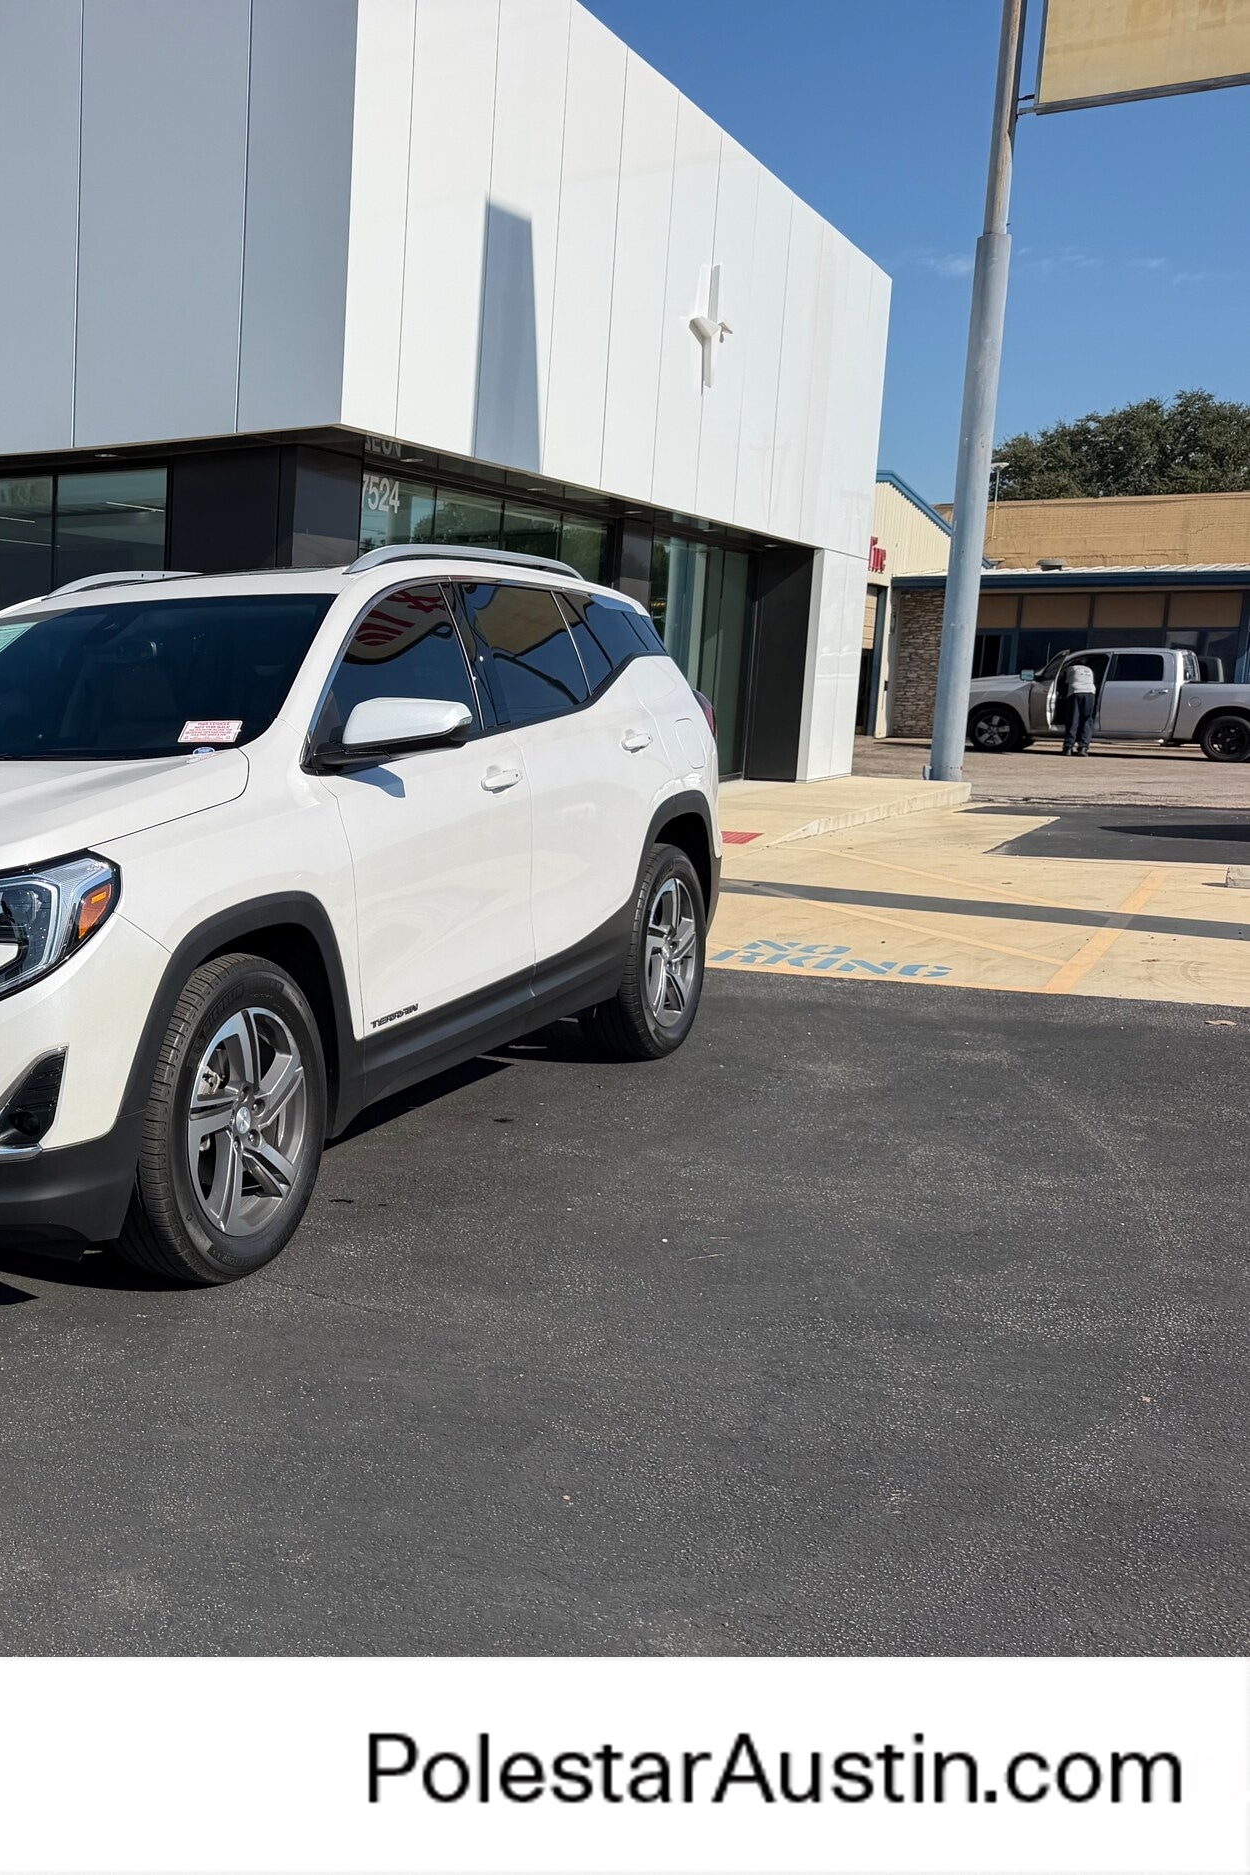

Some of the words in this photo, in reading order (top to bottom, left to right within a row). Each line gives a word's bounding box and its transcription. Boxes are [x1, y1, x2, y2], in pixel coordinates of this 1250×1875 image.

[362, 474, 400, 513] 7524
[742, 939, 852, 955] NO
[708, 949, 953, 977] RKING
